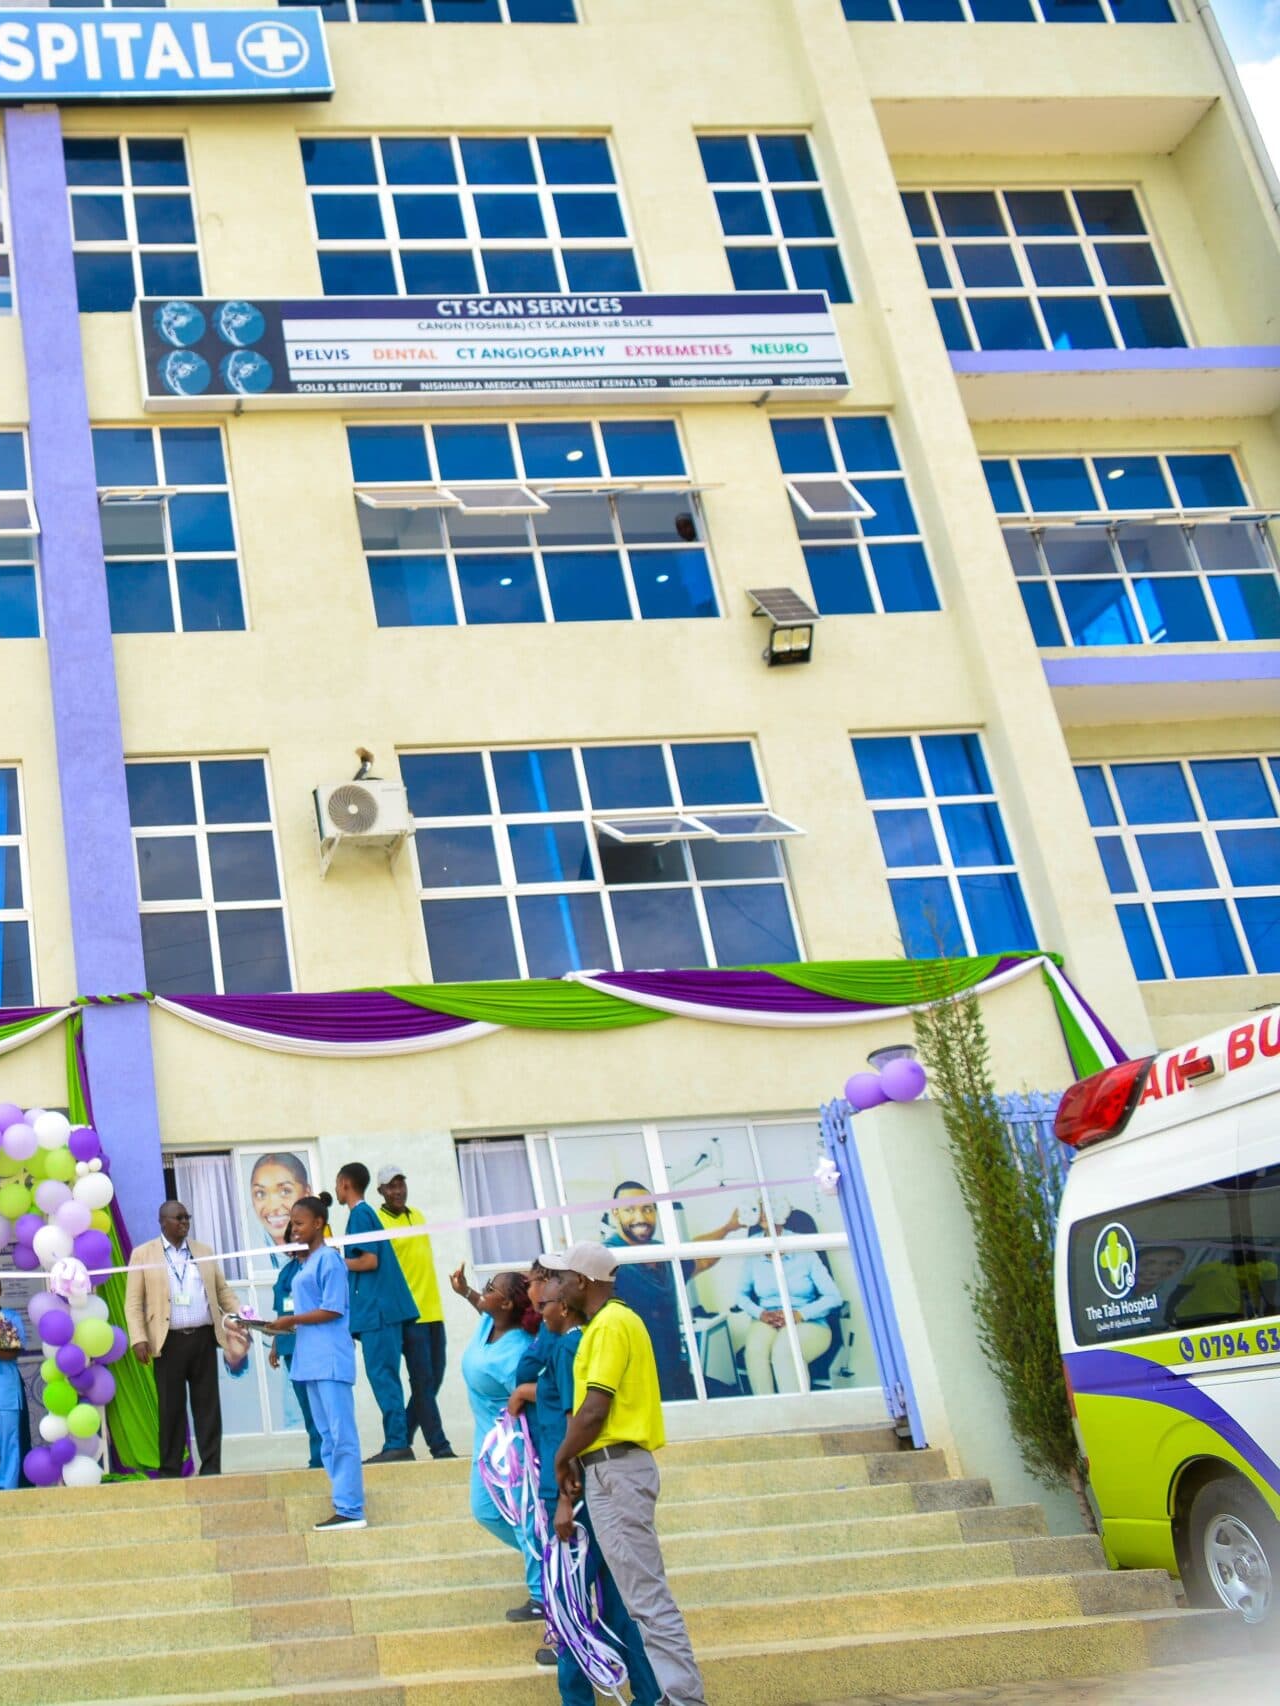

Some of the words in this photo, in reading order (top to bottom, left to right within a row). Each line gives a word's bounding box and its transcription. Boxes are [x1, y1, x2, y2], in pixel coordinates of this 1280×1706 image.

[437, 300, 463, 315] CT
[467, 300, 522, 315] SCAN
[527, 298, 623, 314] SERVICES
[417, 321, 461, 331] CANON
[465, 320, 526, 332] (TOSHIBA)
[528, 319, 543, 329] CT
[545, 318, 600, 329] SCANNER
[623, 318, 654, 328] SLICE
[295, 348, 351, 361] PELVIS
[373, 348, 438, 361] DENTAL
[456, 347, 478, 360] CT
[481, 345, 606, 359] ANGIOGRAPHY
[624, 343, 733, 356] EXTREMETIES
[751, 342, 809, 355] NEURO
[296, 383, 326, 393] SOLD
[328, 383, 335, 392] &
[336, 382, 387, 392] SERVICED
[389, 381, 403, 391] BY
[421, 380, 482, 391] NISHIMURA
[484, 380, 531, 390] MEDICAL
[533, 378, 600, 389] INSTRUMENT
[601, 378, 637, 388] KENYA
[637, 378, 658, 387] LTD
[1086, 1306, 1103, 1320] The
[1102, 1302, 1121, 1318] Tala
[1120, 1293, 1158, 1315] Hospital
[1200, 1332, 1250, 1358] 0794
[1256, 1327, 1280, 1352] 63
